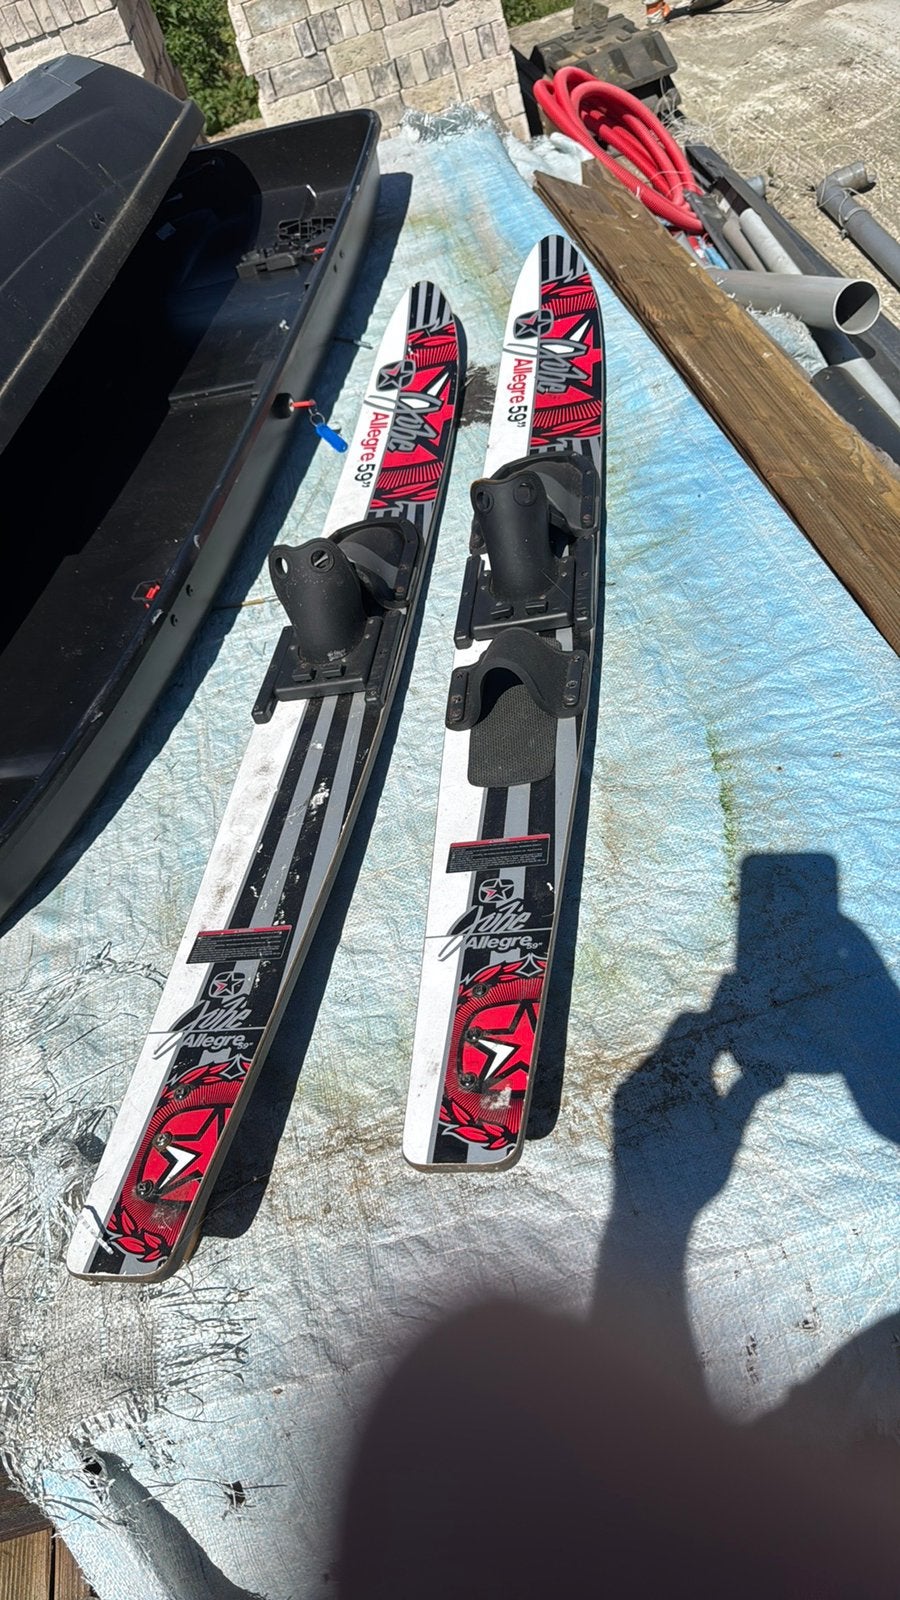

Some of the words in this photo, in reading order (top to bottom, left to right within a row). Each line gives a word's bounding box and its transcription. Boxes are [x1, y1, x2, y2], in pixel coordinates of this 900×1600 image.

[503, 338, 588, 394] Jobe
[507, 358, 533, 405] Allegre
[360, 411, 390, 462] Allegre
[363, 391, 443, 453] Jobe
[438, 900, 531, 962] Jobe
[466, 935, 533, 951] Allegre
[152, 997, 252, 1060] Jobe
[182, 1034, 246, 1048] Allegre
